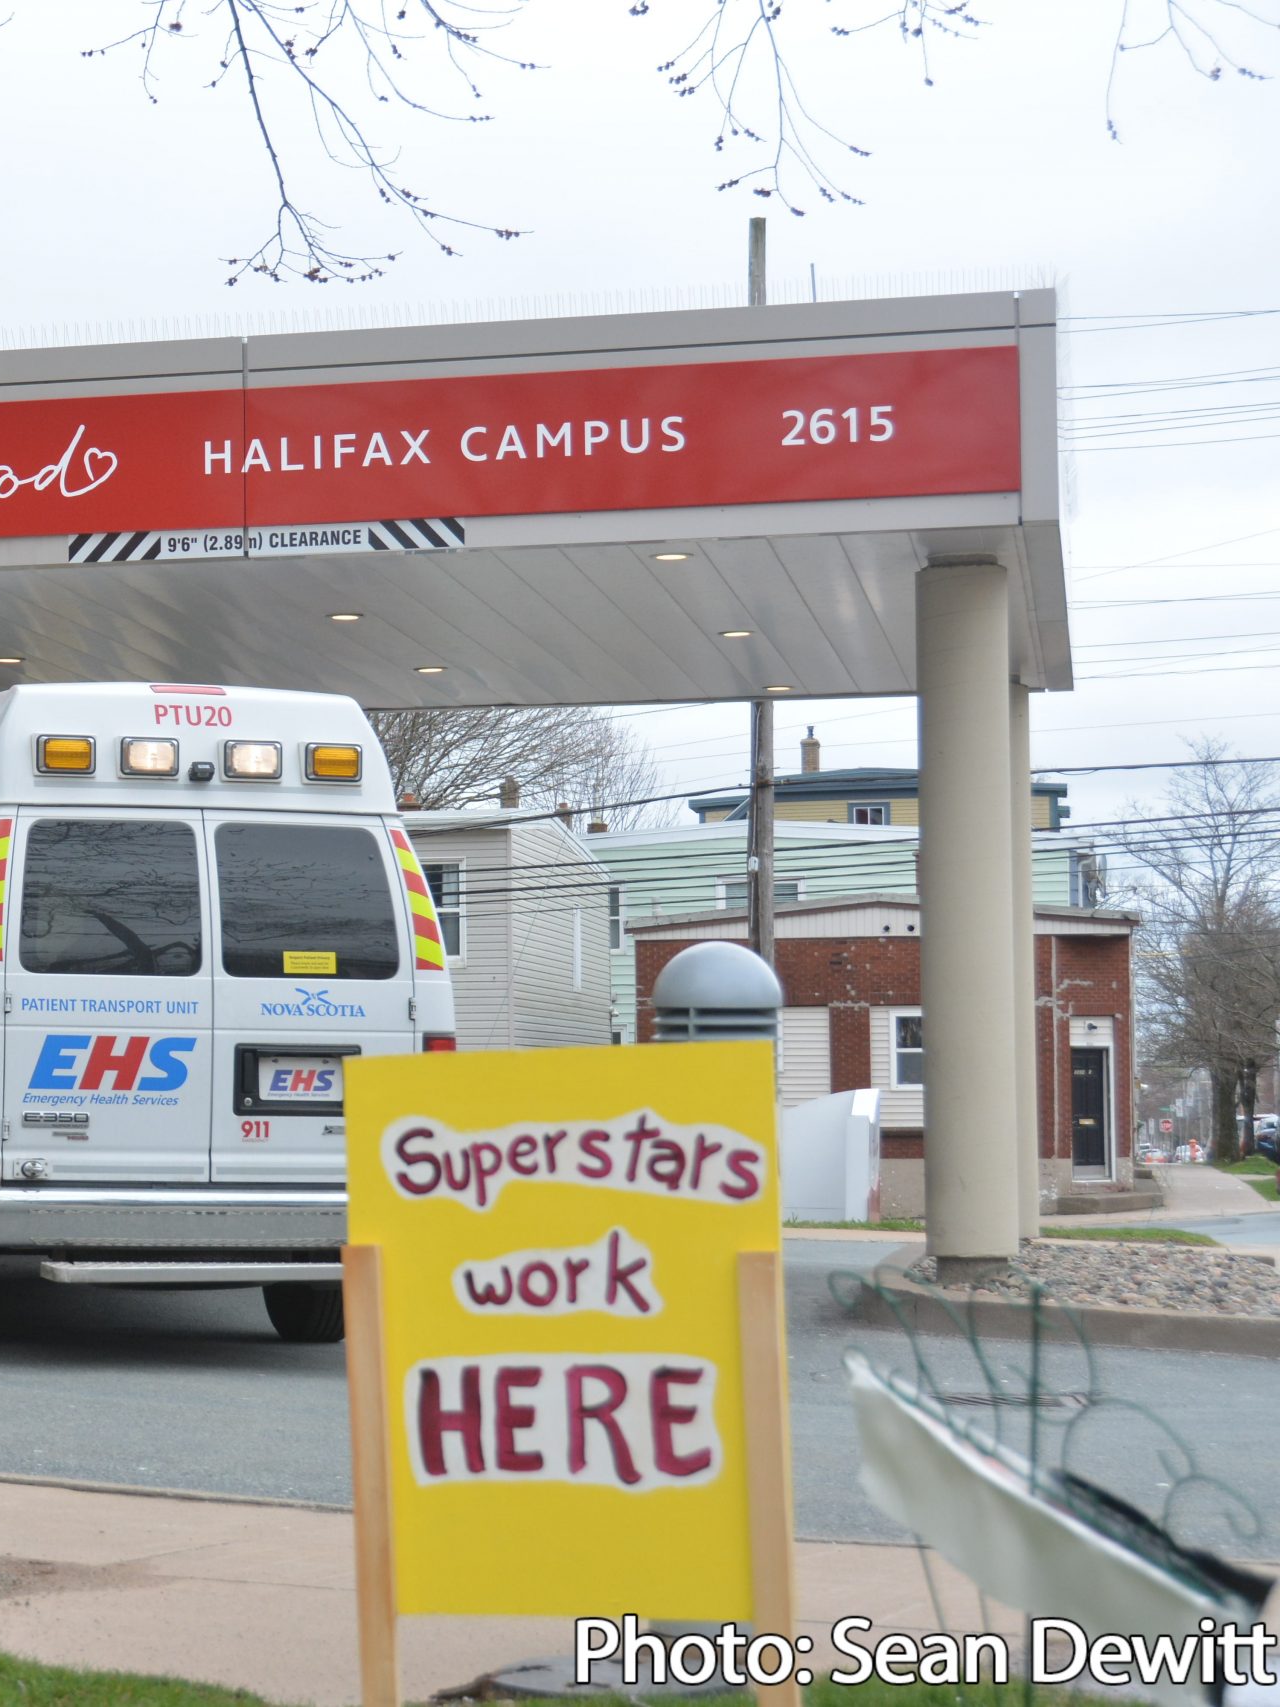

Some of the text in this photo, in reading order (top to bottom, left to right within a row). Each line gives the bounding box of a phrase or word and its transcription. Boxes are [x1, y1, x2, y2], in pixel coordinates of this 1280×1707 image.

[781, 404, 895, 447] 2615
[202, 415, 687, 476] HALIFAX CAMPUS
[269, 528, 362, 549] CLEARANCE
[154, 703, 233, 728] PTU20
[21, 997, 199, 1015] PATIENT TRANSPORT UNIT
[260, 1002, 367, 1018] NOVA SCOTIA
[28, 1034, 198, 1092] EHS
[269, 1069, 336, 1092] EHS
[22, 1092, 180, 1107] Emergency Health Services
[23, 1111, 89, 1123] E-350
[241, 1120, 269, 1138] 911
[394, 1113, 762, 1208] Superstars
[464, 1230, 650, 1314] work
[418, 1365, 713, 1485] HERE
